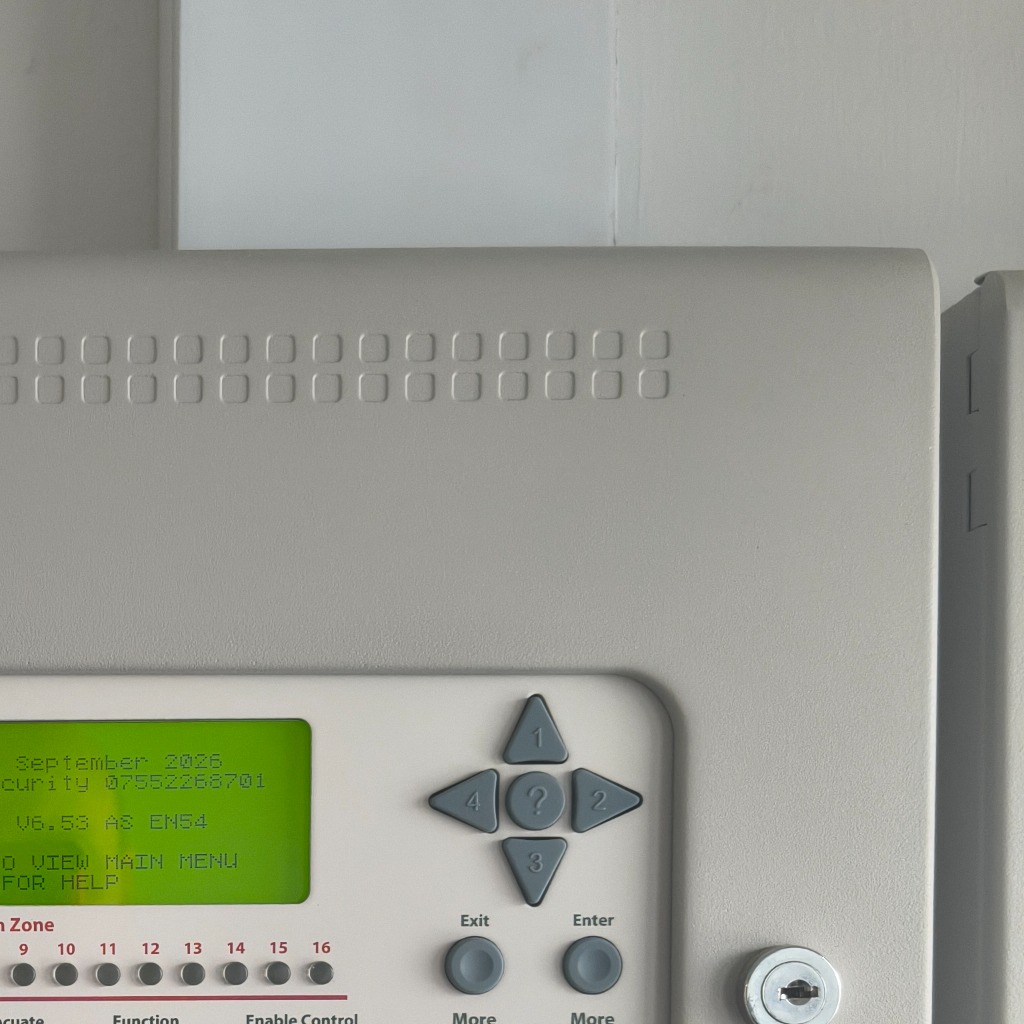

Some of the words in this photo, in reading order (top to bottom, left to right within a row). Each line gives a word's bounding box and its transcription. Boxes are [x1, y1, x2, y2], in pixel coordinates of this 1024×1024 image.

[532, 728, 543, 748] 1
[16, 755, 148, 774] September
[165, 754, 223, 770] 2026
[106, 773, 265, 790] 07552268701
[466, 791, 481, 811] 4
[529, 786, 548, 815] ?
[592, 791, 607, 811] 2
[17, 815, 89, 831] V6.53
[106, 814, 133, 830] AS
[150, 813, 208, 830] EN54
[32, 854, 89, 870] VIEW
[106, 853, 163, 870] MAIN
[179, 853, 238, 869] MENU
[528, 853, 543, 873] 3
[2, 875, 45, 890] FOR
[61, 874, 119, 890] HELP
[10, 918, 54, 931] Zone
[461, 914, 489, 927] Exit
[574, 914, 614, 926] Enter
[19, 944, 28, 955] 9
[58, 943, 75, 955] 10
[100, 943, 115, 955] 11
[143, 943, 159, 954] 12
[185, 943, 201, 954] 13
[228, 942, 245, 954] 14
[270, 942, 287, 953] 15
[313, 942, 330, 953] 16
